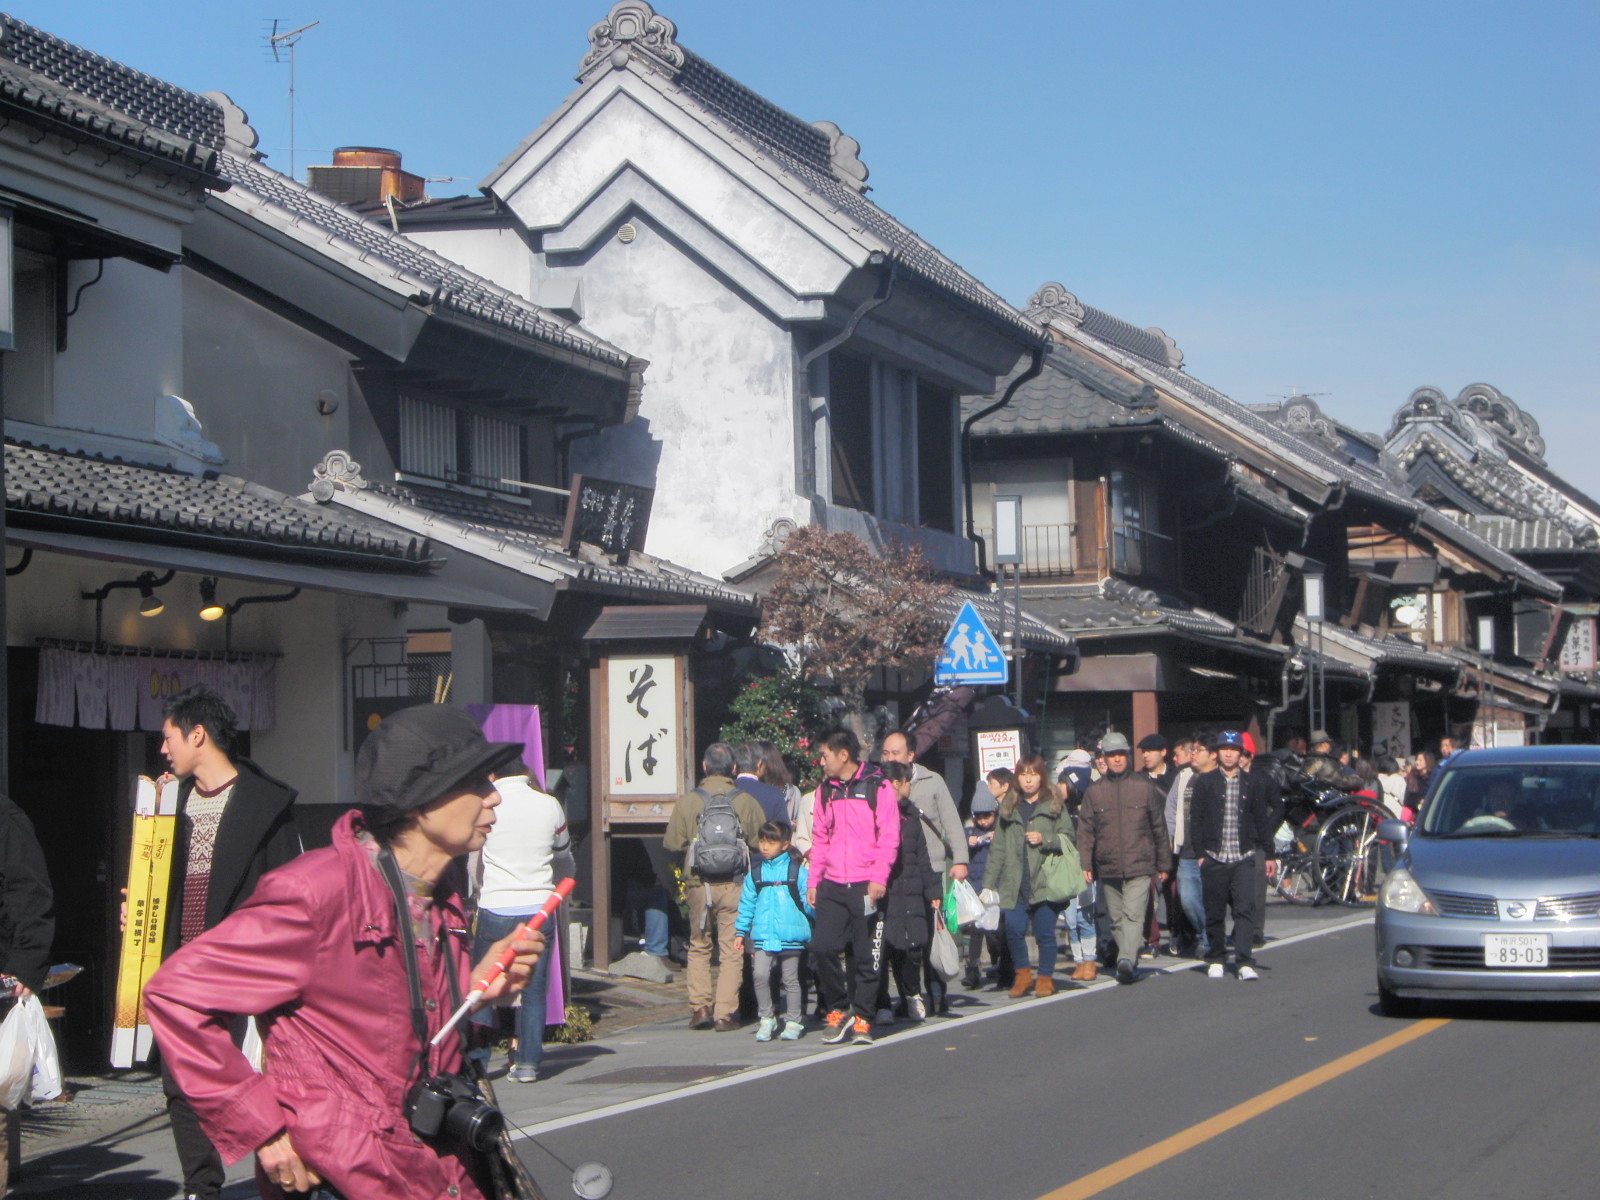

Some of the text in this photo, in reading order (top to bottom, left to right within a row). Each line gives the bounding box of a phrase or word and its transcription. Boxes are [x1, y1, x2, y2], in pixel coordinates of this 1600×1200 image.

[626, 664, 668, 783] そば
[871, 921, 884, 971] adidas
[1499, 947, 1544, 963] 89-03
[1518, 936, 1533, 945] 501
